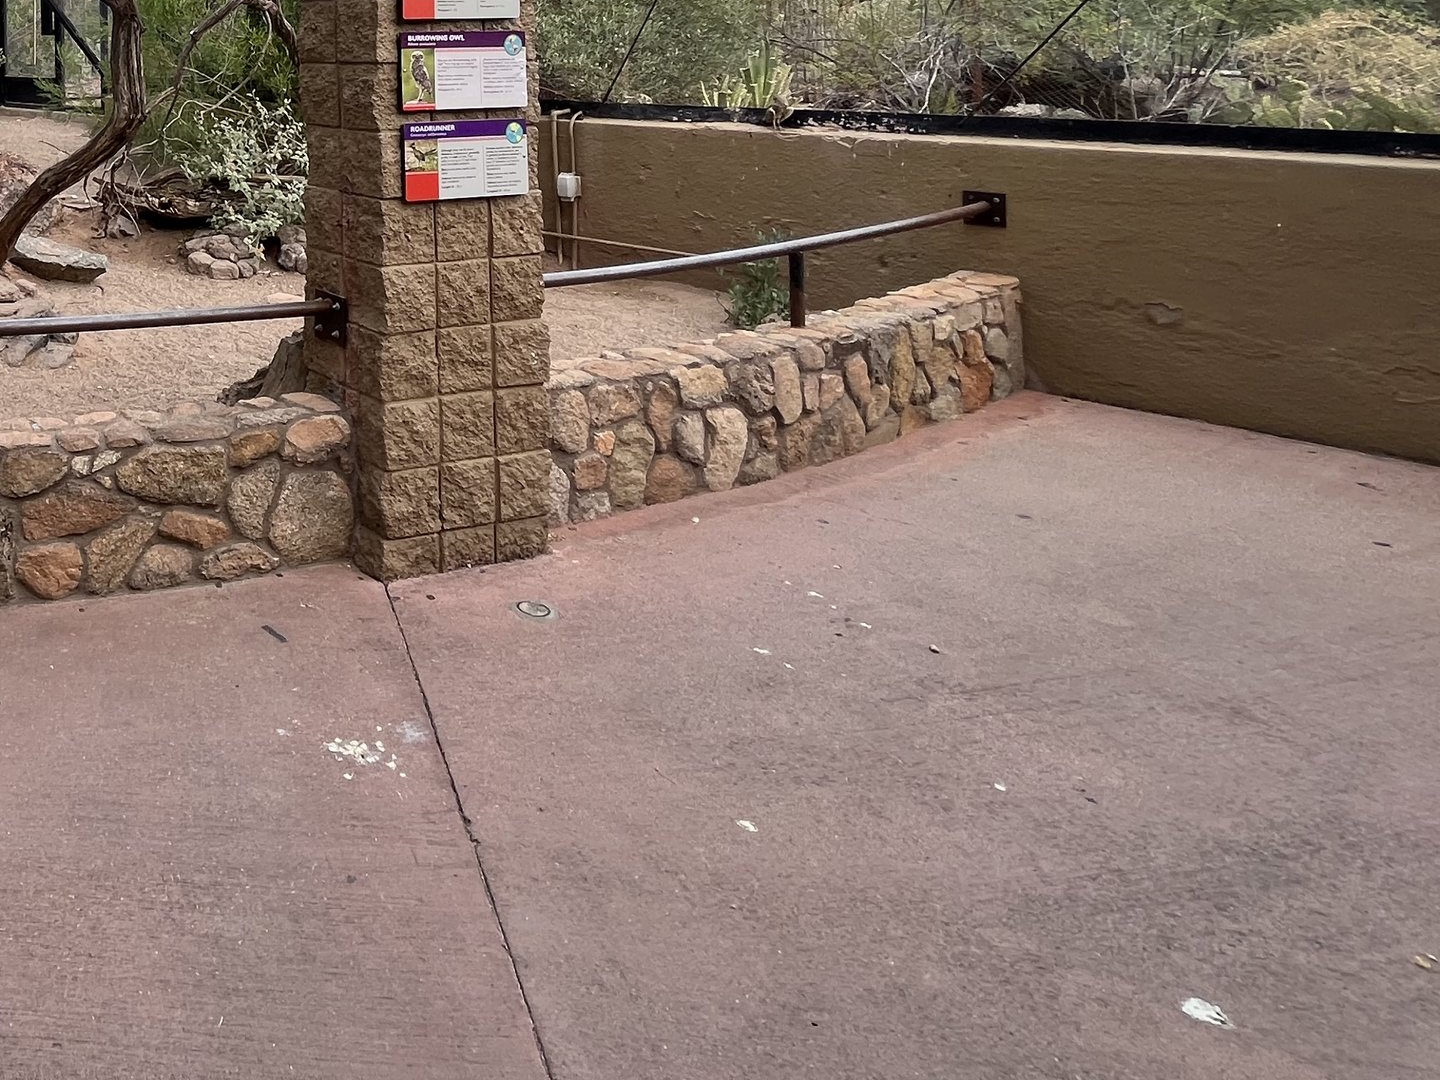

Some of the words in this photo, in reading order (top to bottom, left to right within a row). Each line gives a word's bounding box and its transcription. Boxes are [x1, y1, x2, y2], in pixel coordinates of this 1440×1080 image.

[407, 34, 448, 42] BURROWING
[449, 34, 465, 42] OWL
[410, 124, 456, 133] ROADRUNNER
